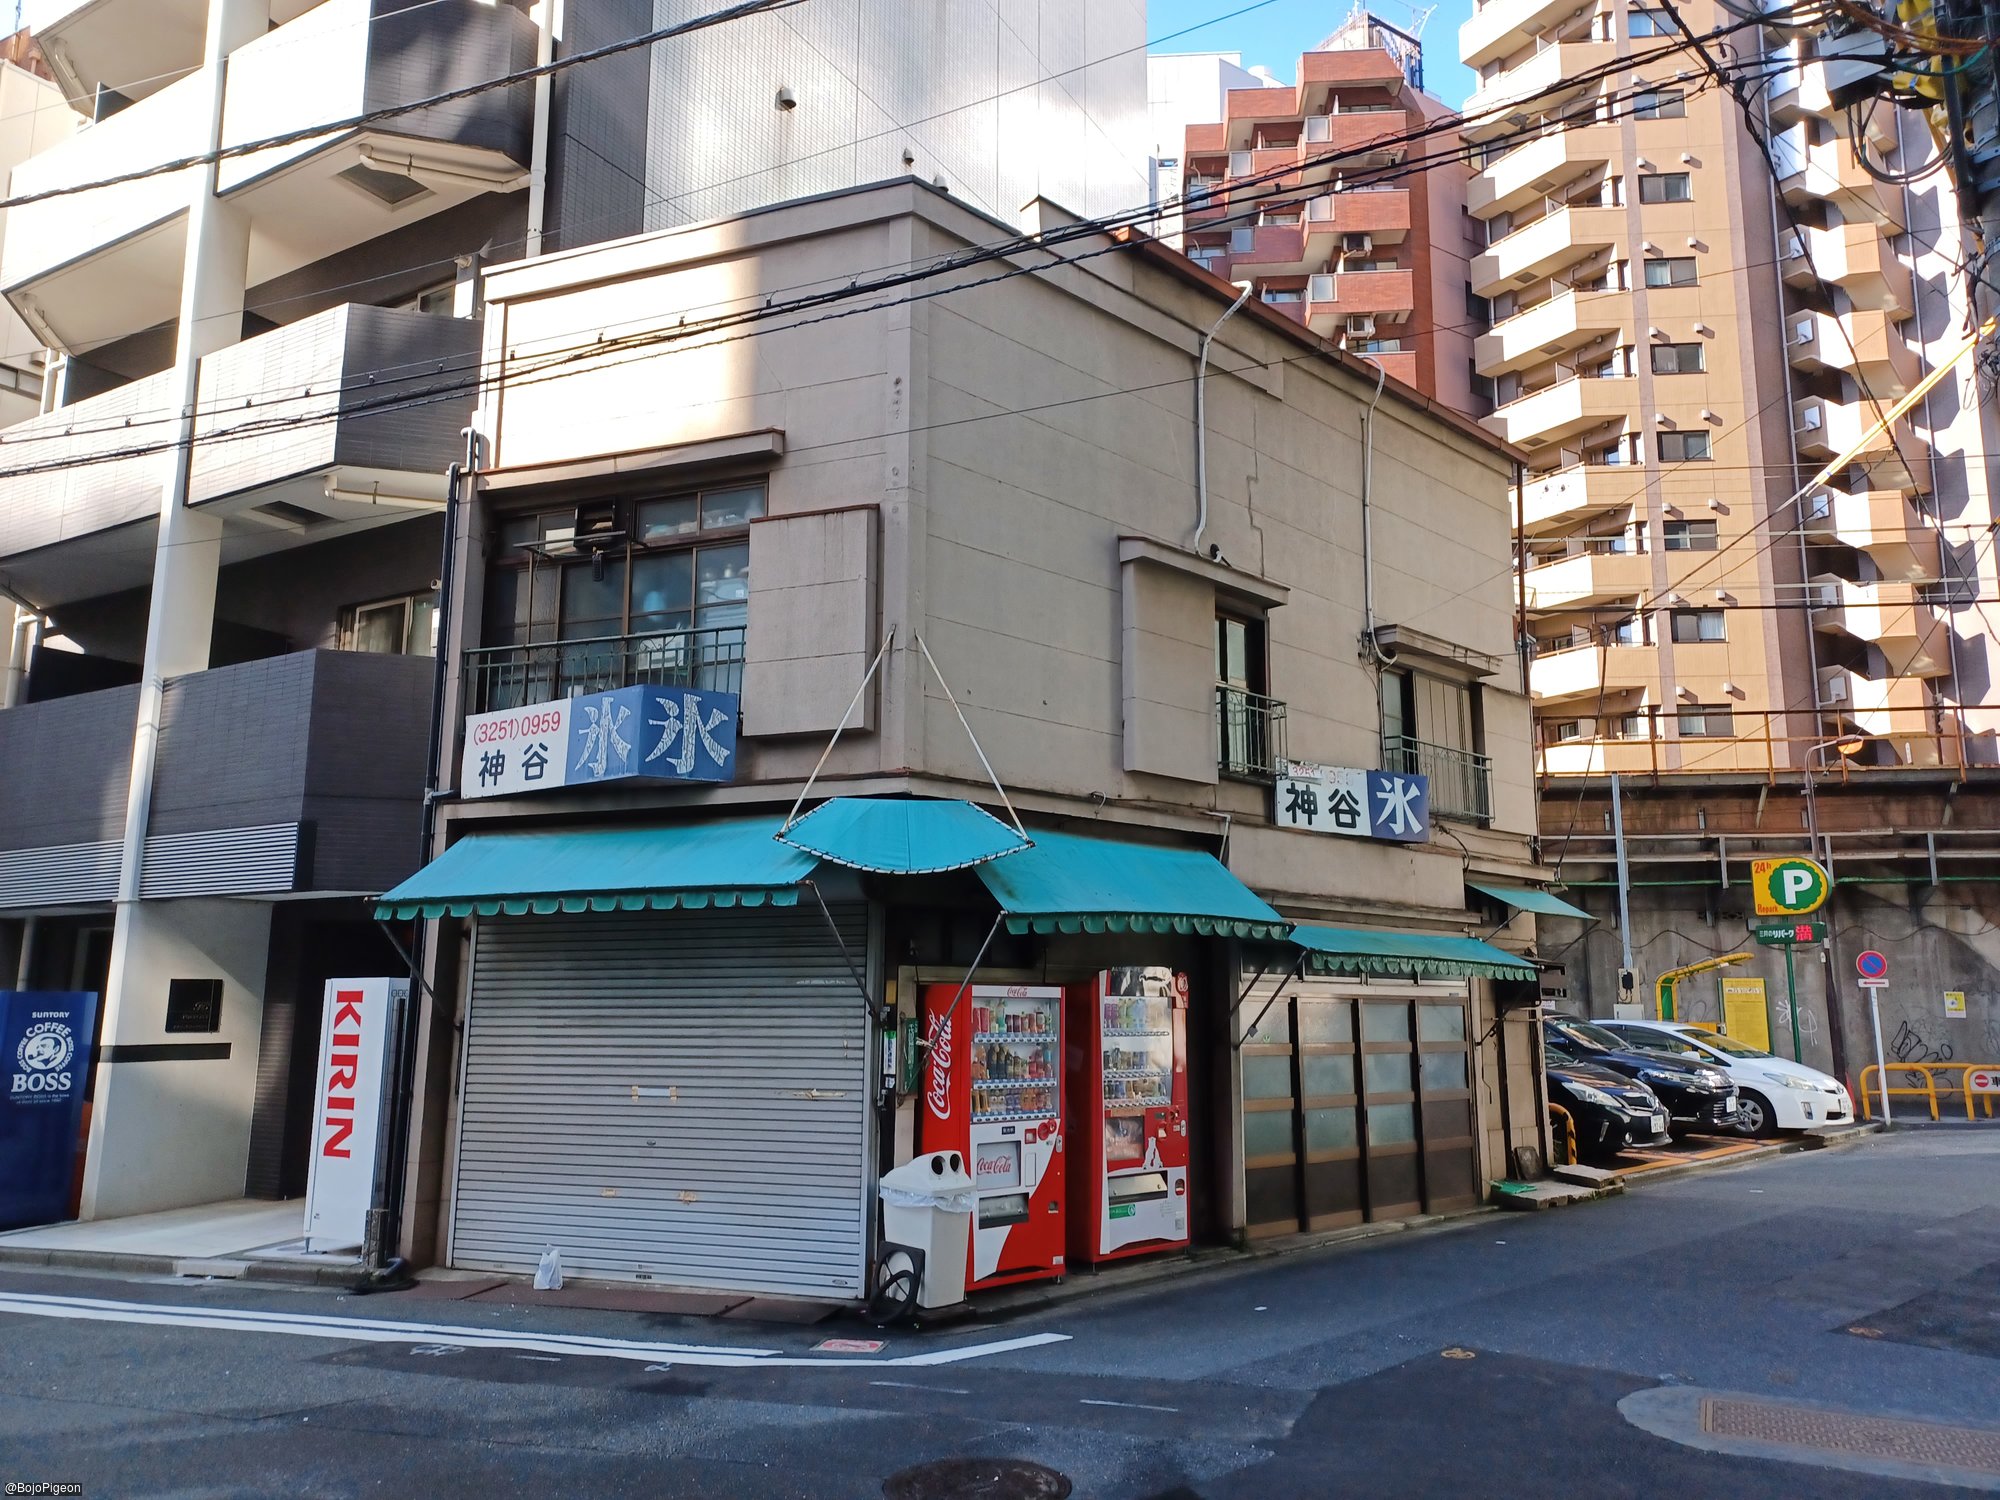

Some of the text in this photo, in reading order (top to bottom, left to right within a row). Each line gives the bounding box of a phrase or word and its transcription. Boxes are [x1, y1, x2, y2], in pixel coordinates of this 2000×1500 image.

[474, 711, 561, 746] (3251)0959
[479, 697, 631, 787] 神谷 氷
[645, 694, 730, 774] 氷
[1285, 777, 1423, 835] 神谷 氷
[1783, 869, 1813, 904] P
[26, 1022, 71, 1037] COFFEE
[11, 1072, 71, 1092] BOSS
[323, 990, 363, 1159] KIRIN
